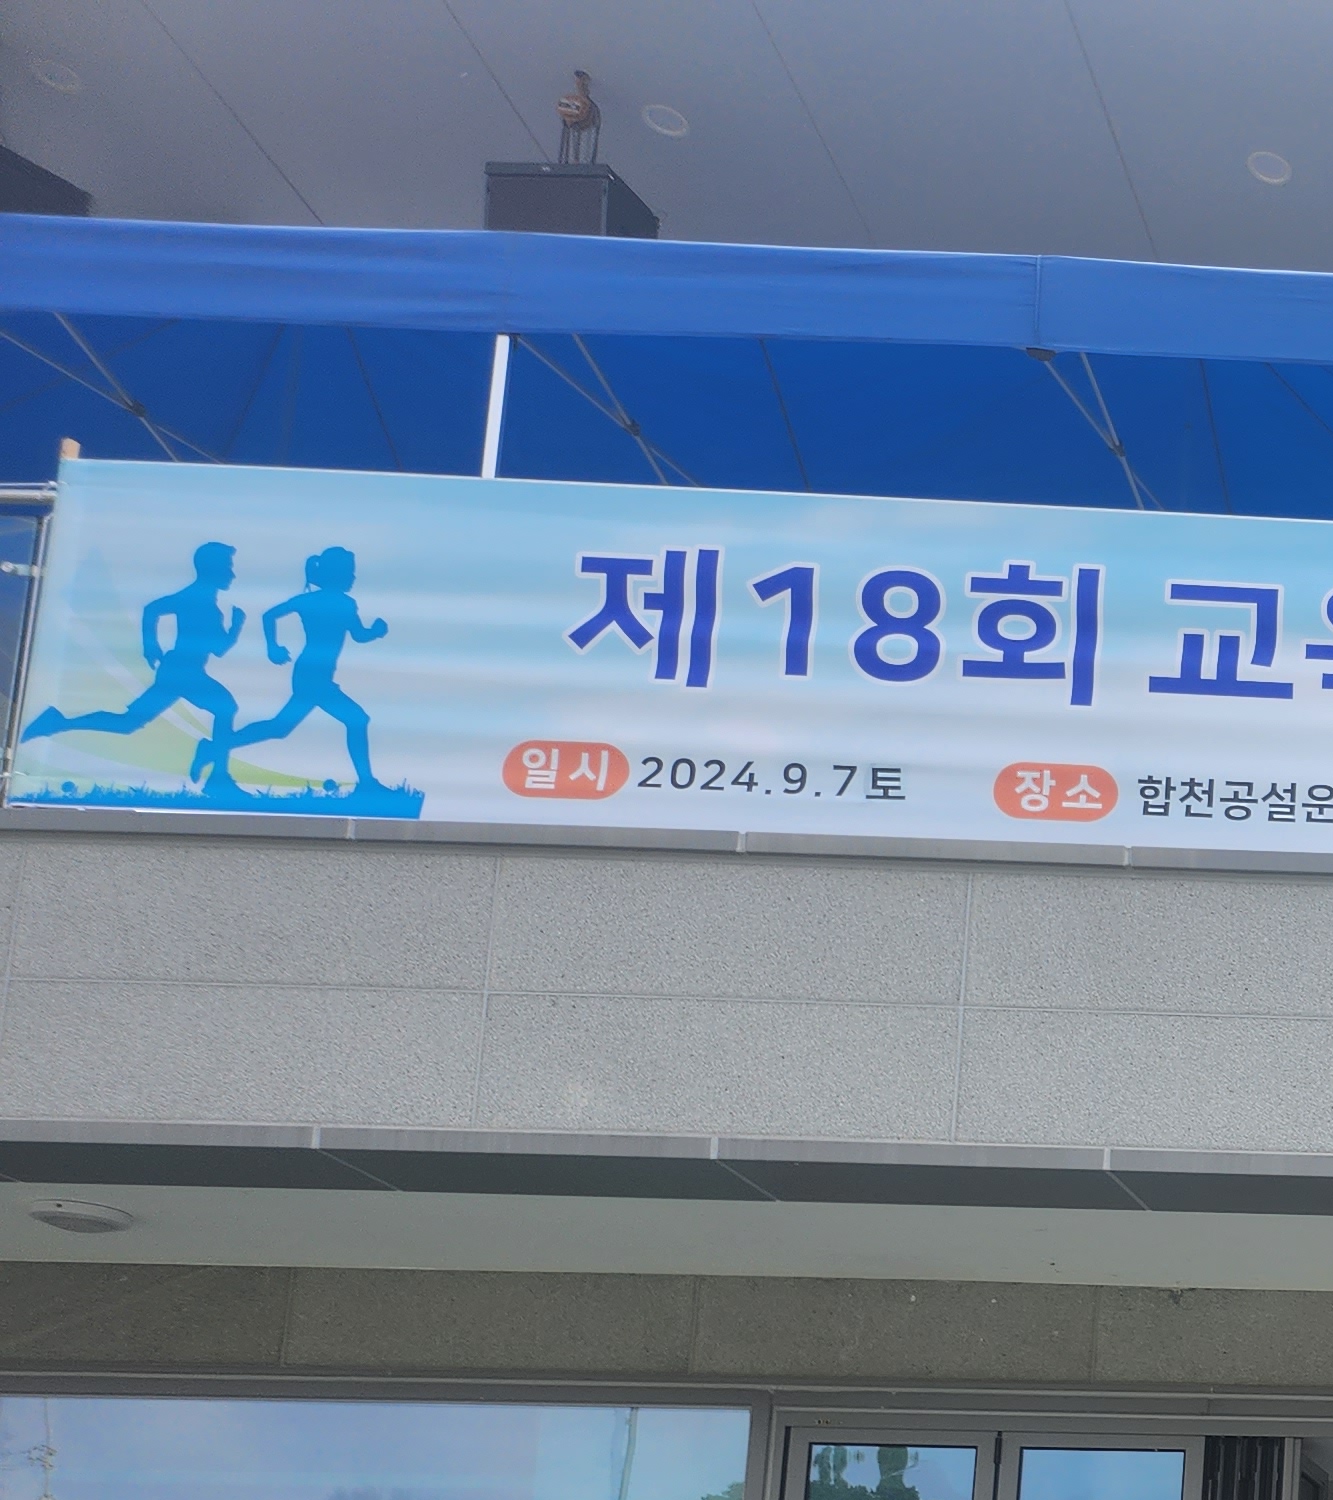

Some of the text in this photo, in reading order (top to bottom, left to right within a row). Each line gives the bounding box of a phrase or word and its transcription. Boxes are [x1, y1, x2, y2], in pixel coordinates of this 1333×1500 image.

[571, 551, 1101, 706] 제18회
[520, 744, 907, 803] 일시 2024.9.7토
[1014, 769, 1104, 813] 장소
